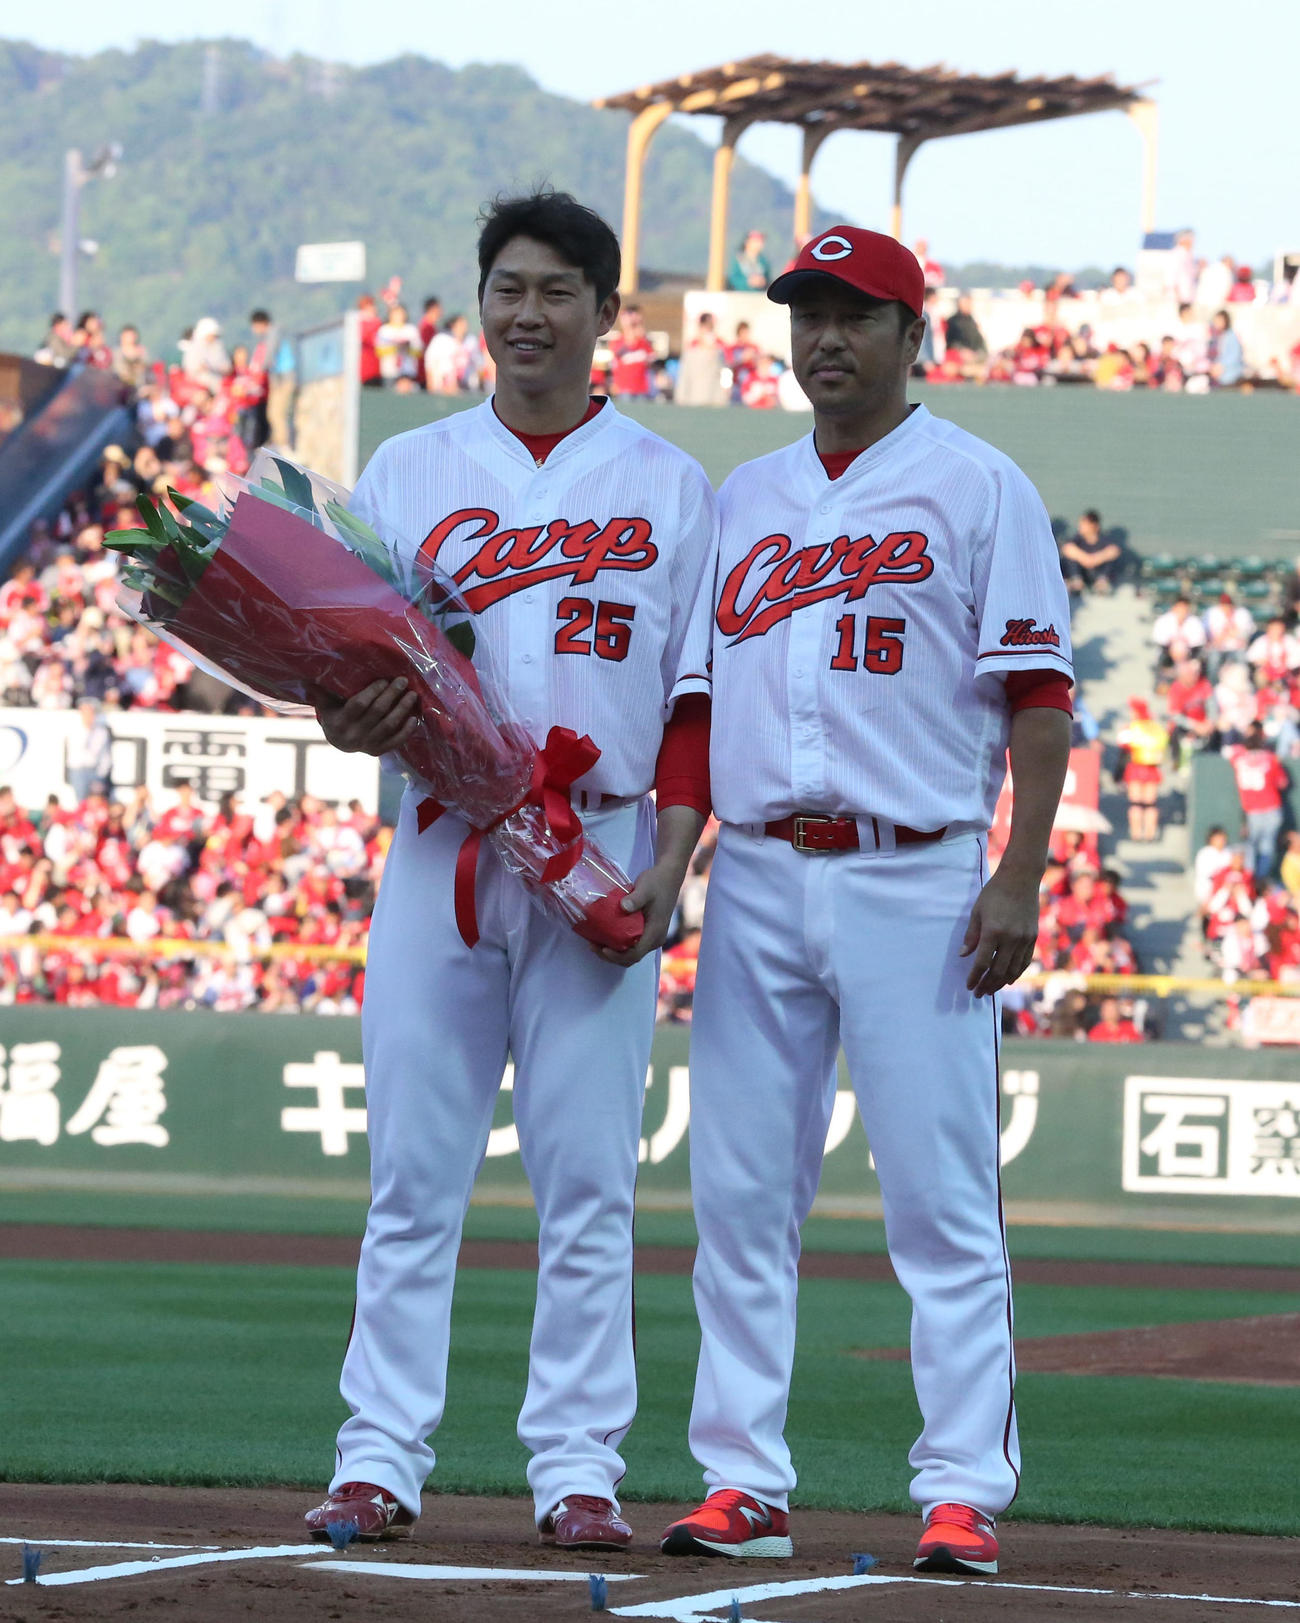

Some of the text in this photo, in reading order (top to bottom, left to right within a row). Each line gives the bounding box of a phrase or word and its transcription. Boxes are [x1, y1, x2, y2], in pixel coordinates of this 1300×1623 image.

[810, 235, 854, 261] C
[414, 507, 659, 615] Carp
[716, 530, 935, 648] Carp
[554, 596, 636, 662] 25
[829, 613, 906, 676] 15
